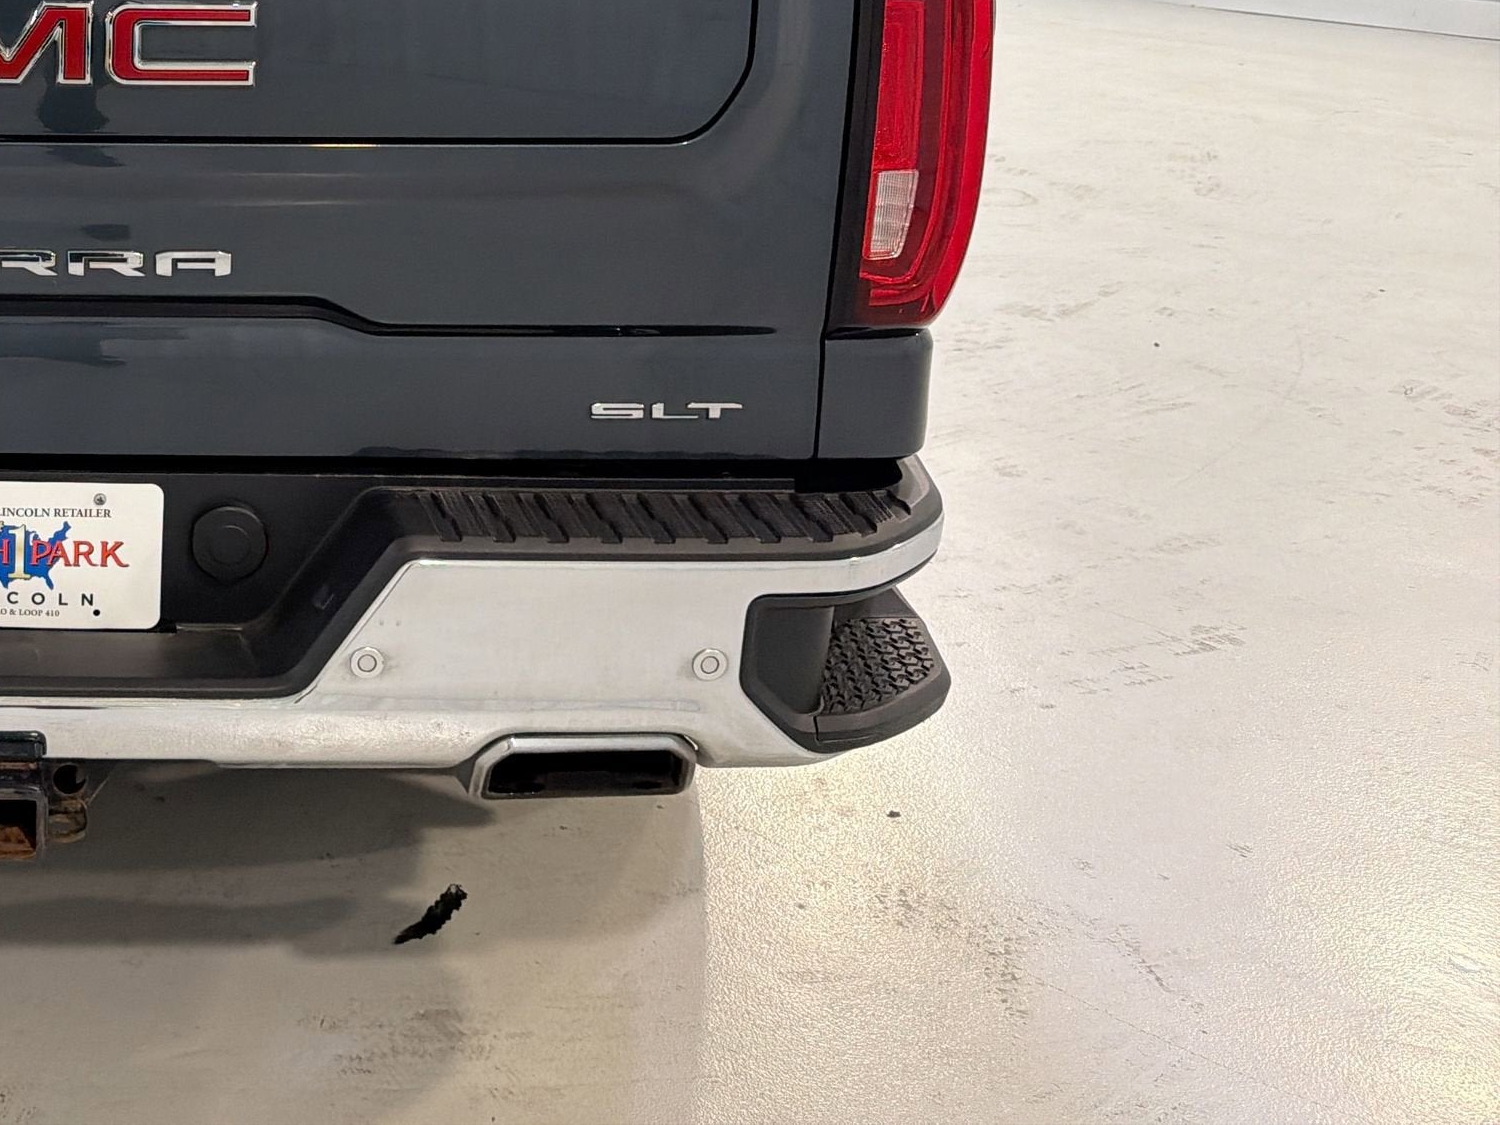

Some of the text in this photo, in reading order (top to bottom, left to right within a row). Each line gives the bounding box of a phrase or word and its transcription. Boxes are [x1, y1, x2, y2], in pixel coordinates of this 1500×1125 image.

[591, 402, 743, 419] SLT
[53, 508, 112, 518] RETAILER
[30, 540, 130, 568] PARK
[9, 607, 17, 616] &
[19, 608, 43, 616] LOOP
[45, 609, 60, 617] 410
